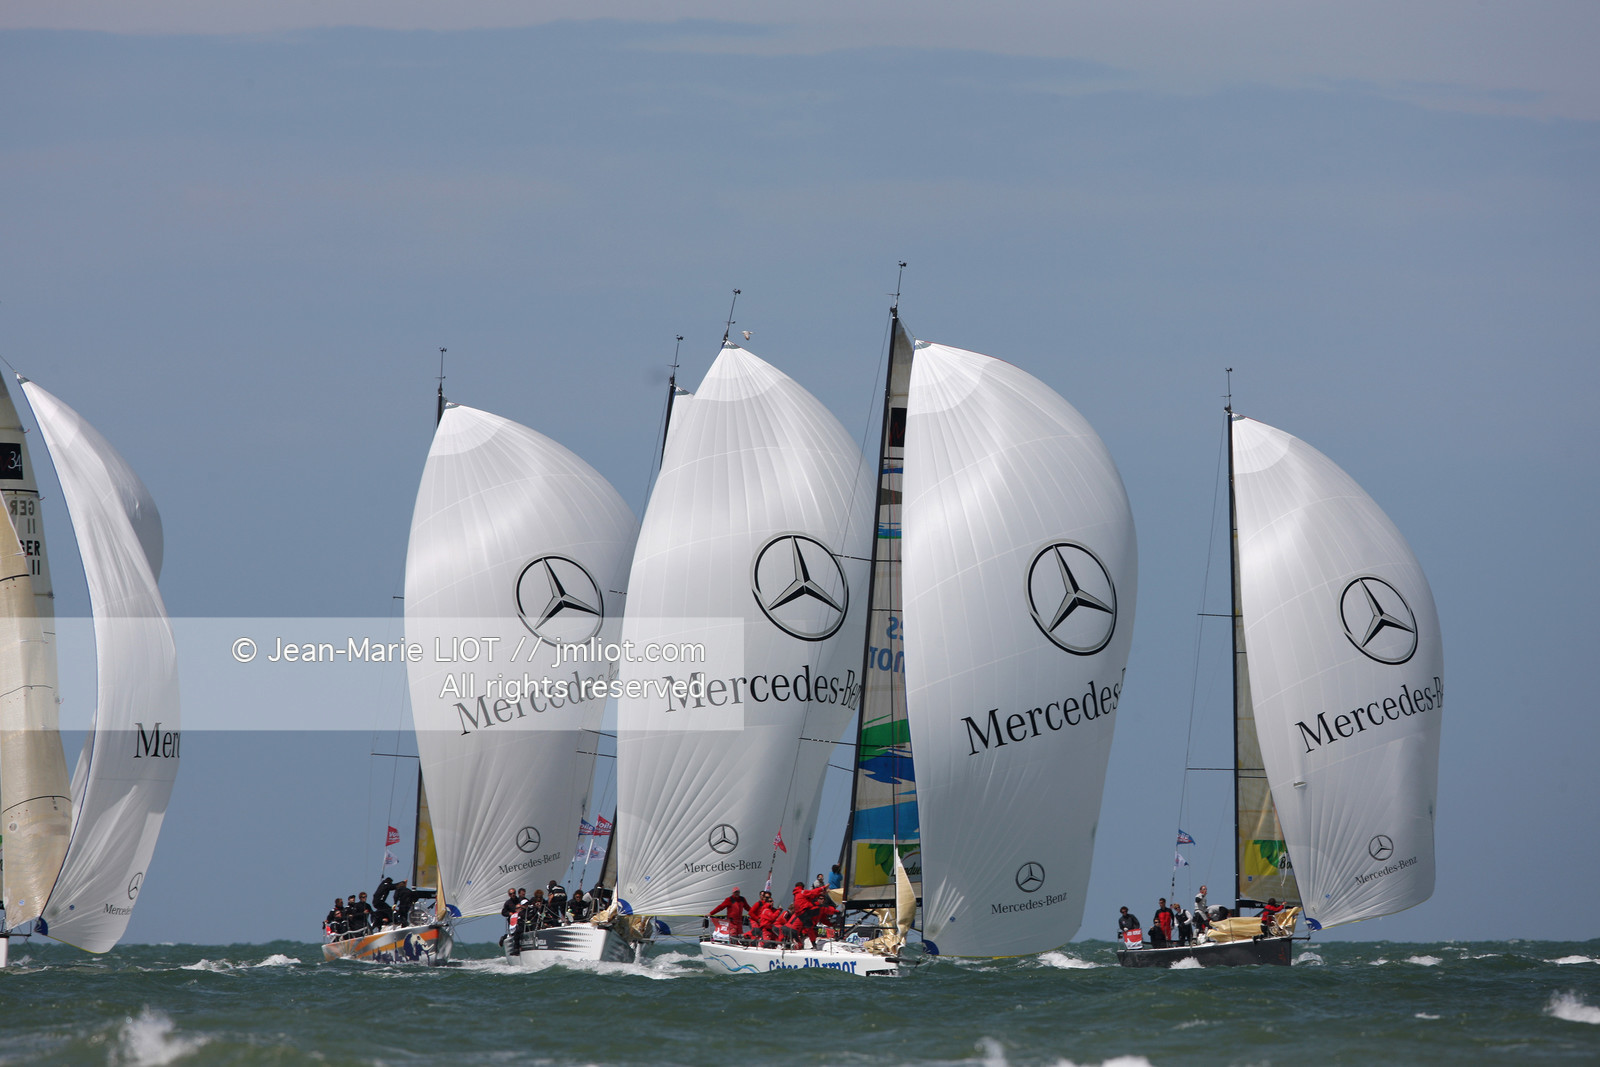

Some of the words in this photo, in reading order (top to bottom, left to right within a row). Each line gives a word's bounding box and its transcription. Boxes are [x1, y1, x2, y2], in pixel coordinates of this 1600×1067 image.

[1295, 676, 1443, 754] Mercedes-B
[498, 852, 561, 875] Mercedes-Benz
[684, 859, 762, 874] Mercedes-Benz
[1354, 856, 1417, 886] Mercedes-Benz
[991, 892, 1067, 915] Mercedes-Benz
